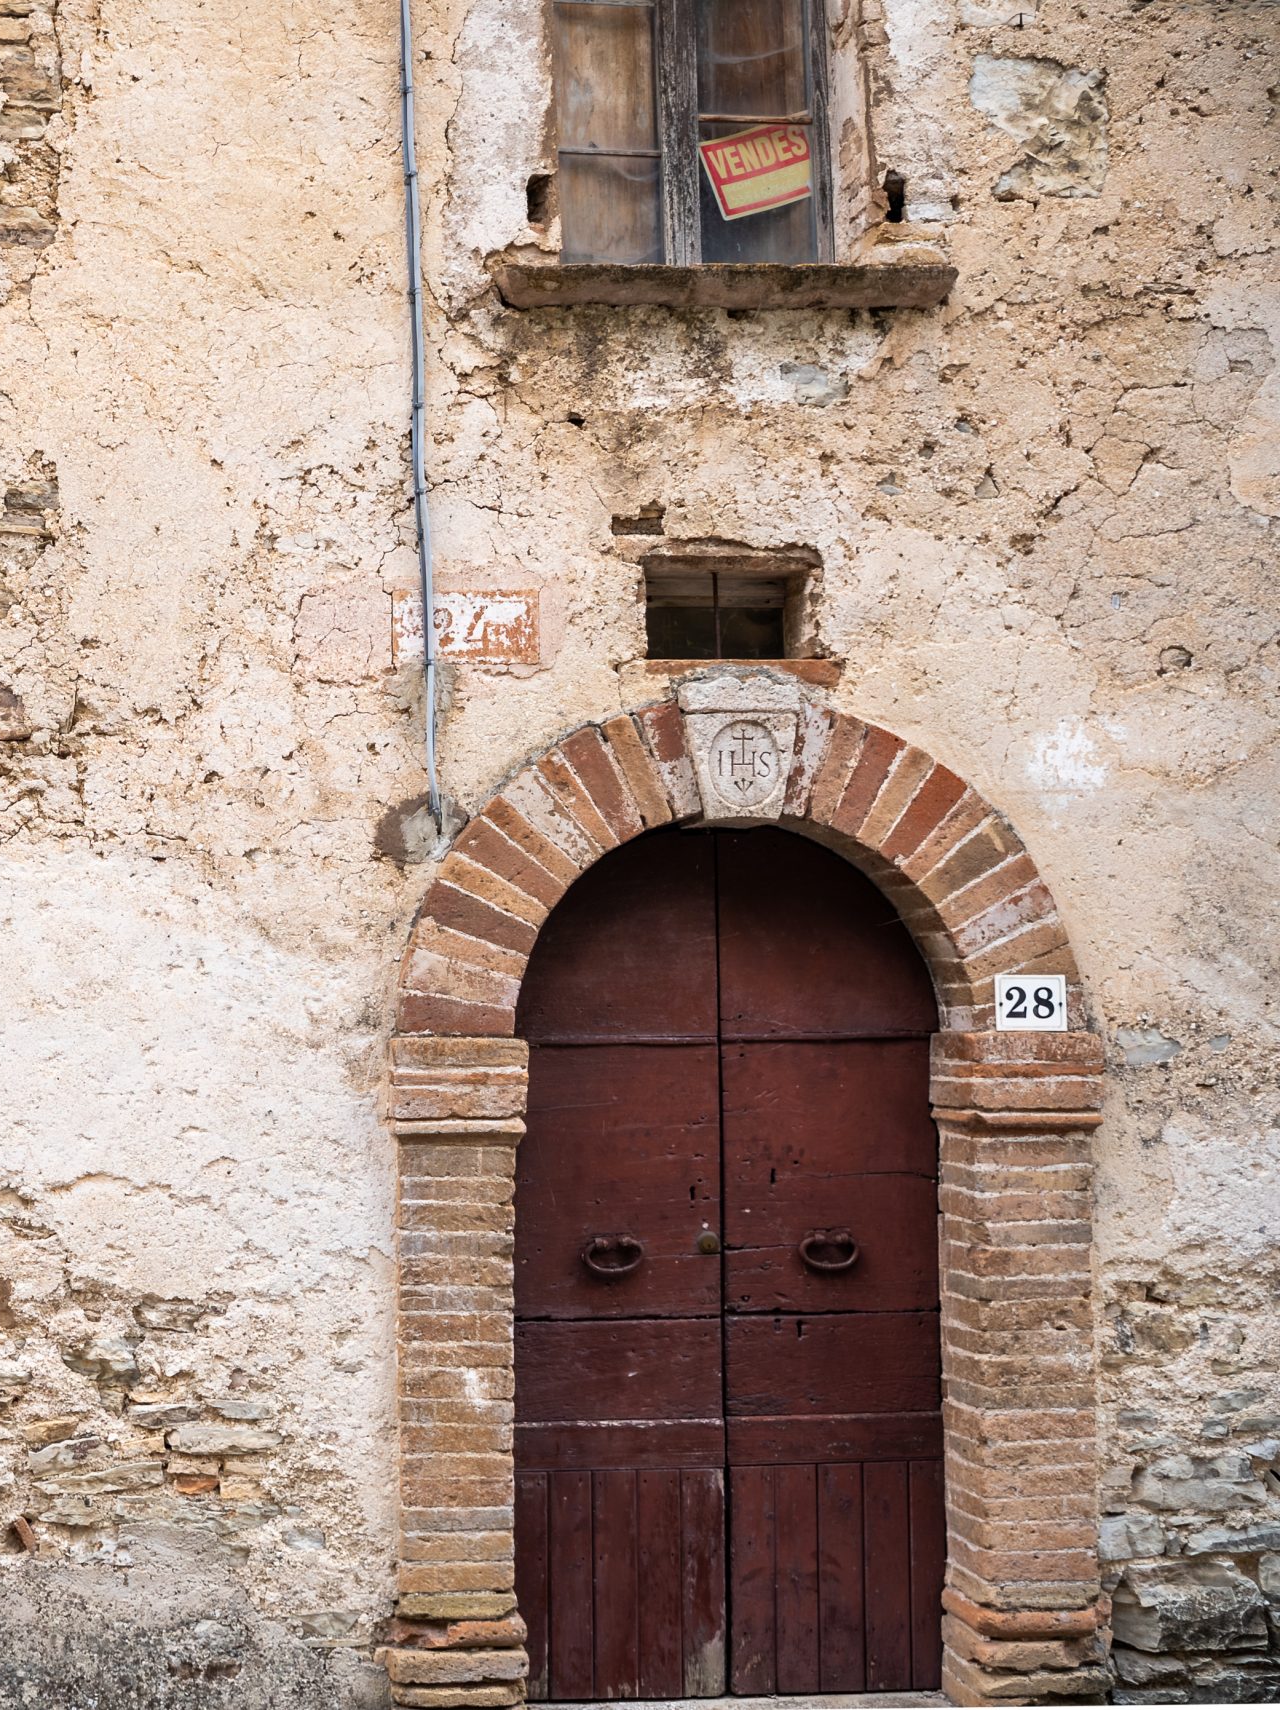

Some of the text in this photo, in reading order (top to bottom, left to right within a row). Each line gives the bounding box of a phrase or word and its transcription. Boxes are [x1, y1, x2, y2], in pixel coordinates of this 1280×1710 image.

[707, 126, 807, 179] VENDES
[718, 750, 771, 777] IHS
[1005, 986, 1055, 1019] 28
